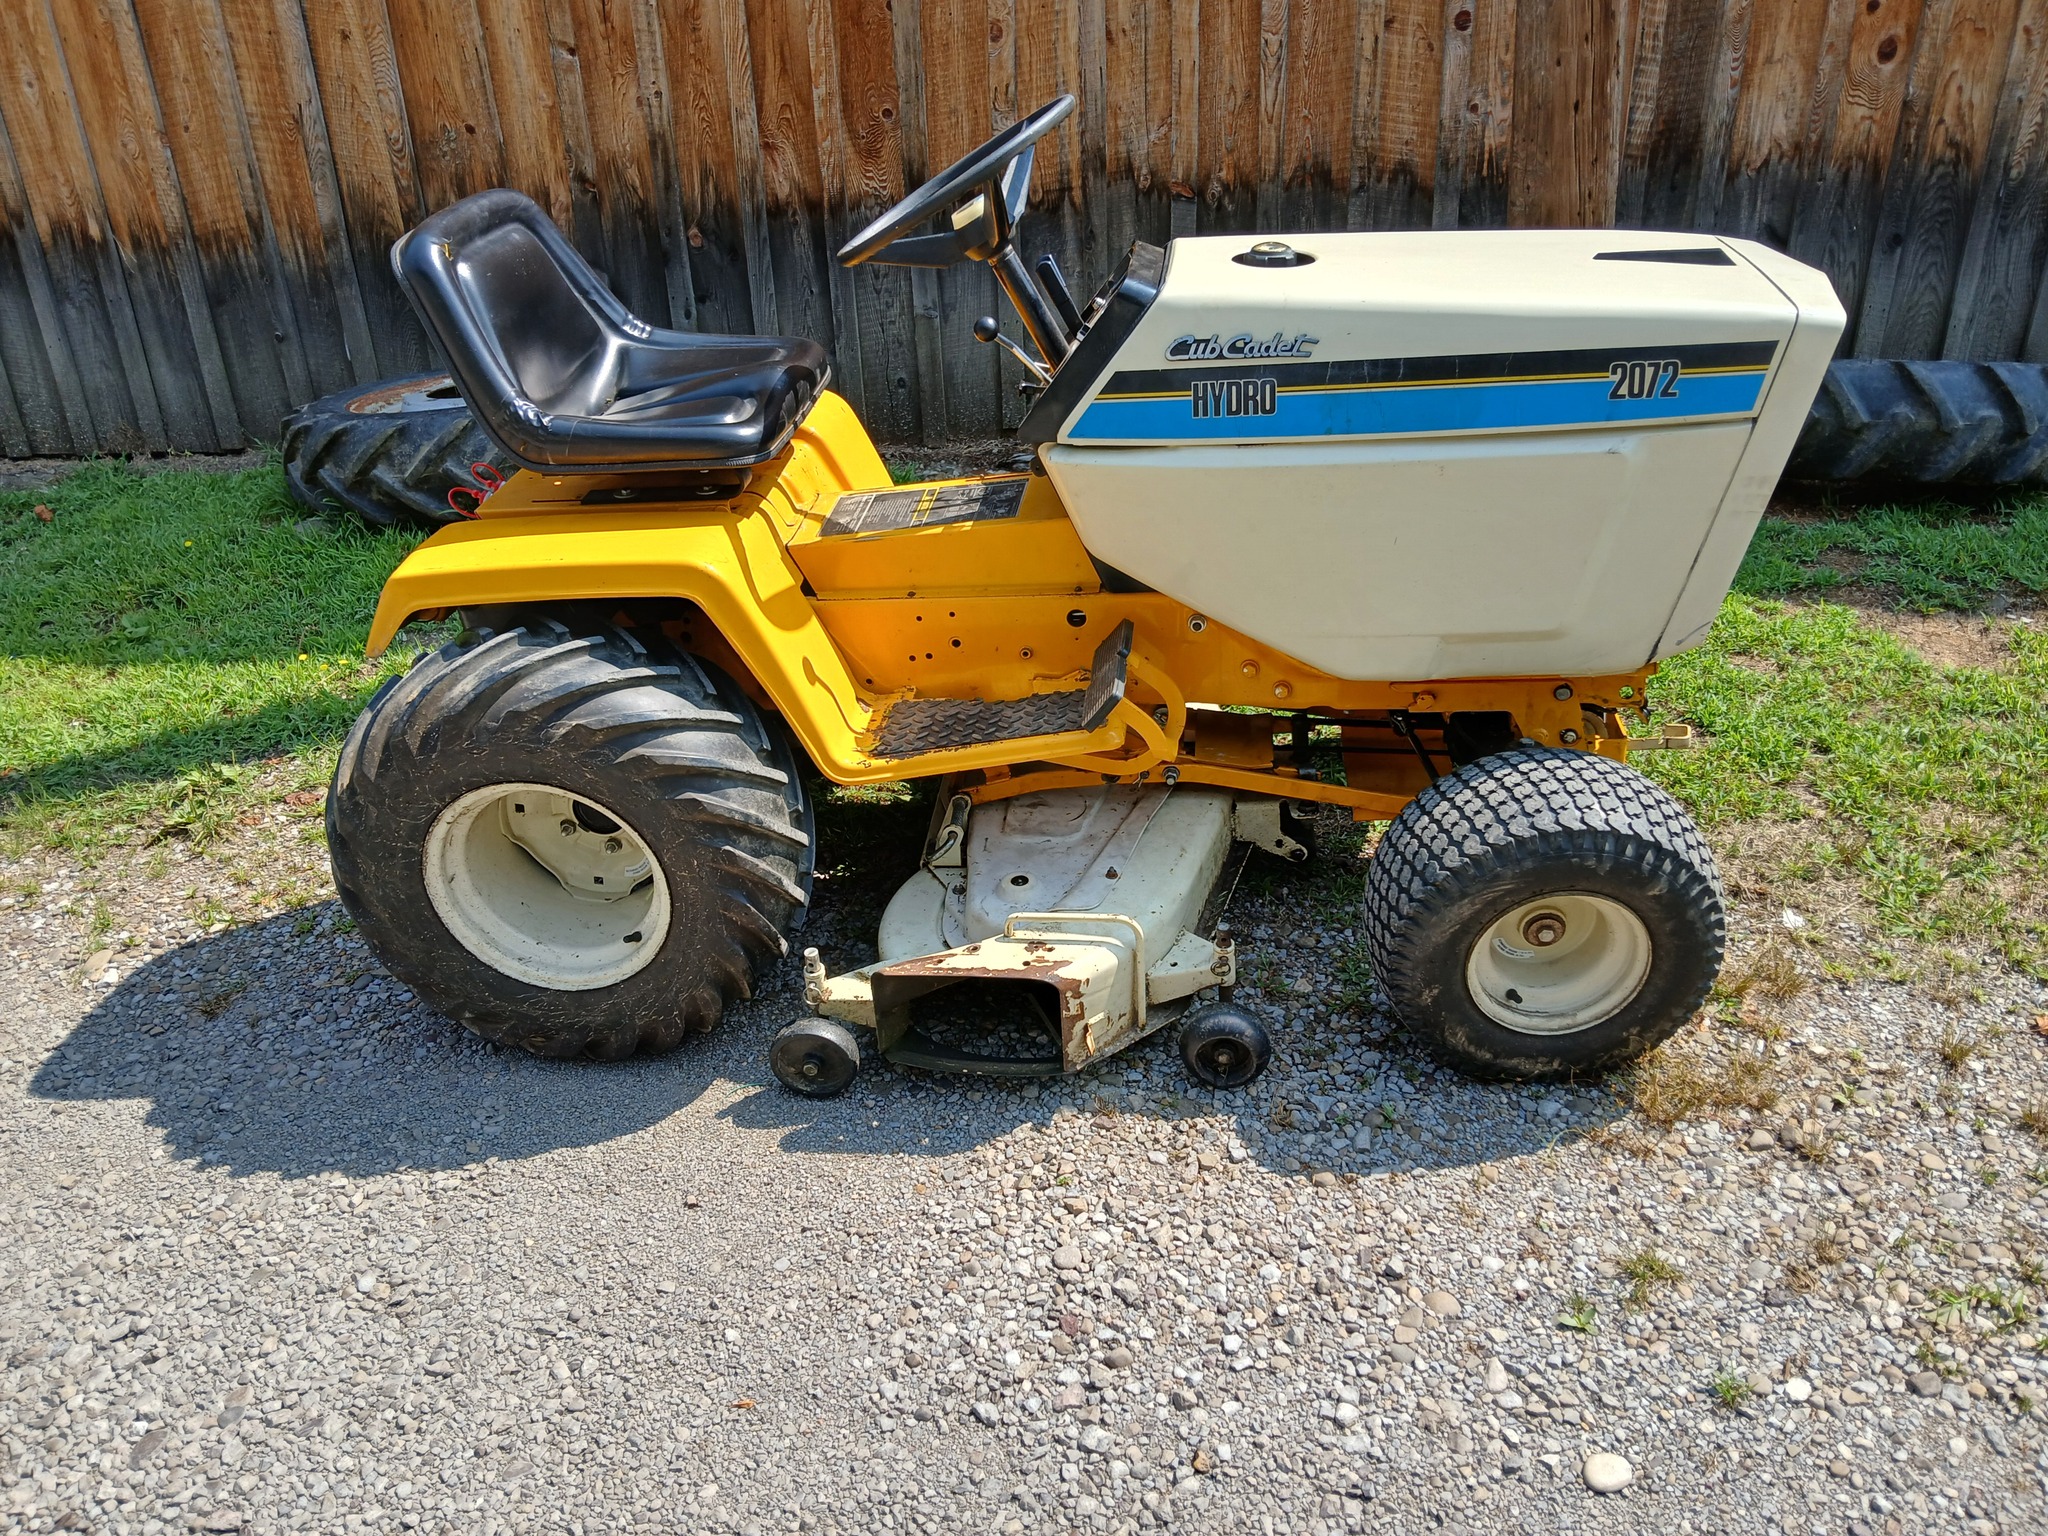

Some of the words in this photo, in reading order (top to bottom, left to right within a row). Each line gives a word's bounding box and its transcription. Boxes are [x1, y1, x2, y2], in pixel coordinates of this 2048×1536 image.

[1165, 334, 1221, 361] Cub
[1222, 333, 1320, 359] Cadet
[1191, 378, 1277, 418] HYDRO
[1608, 360, 1680, 400] 2072
